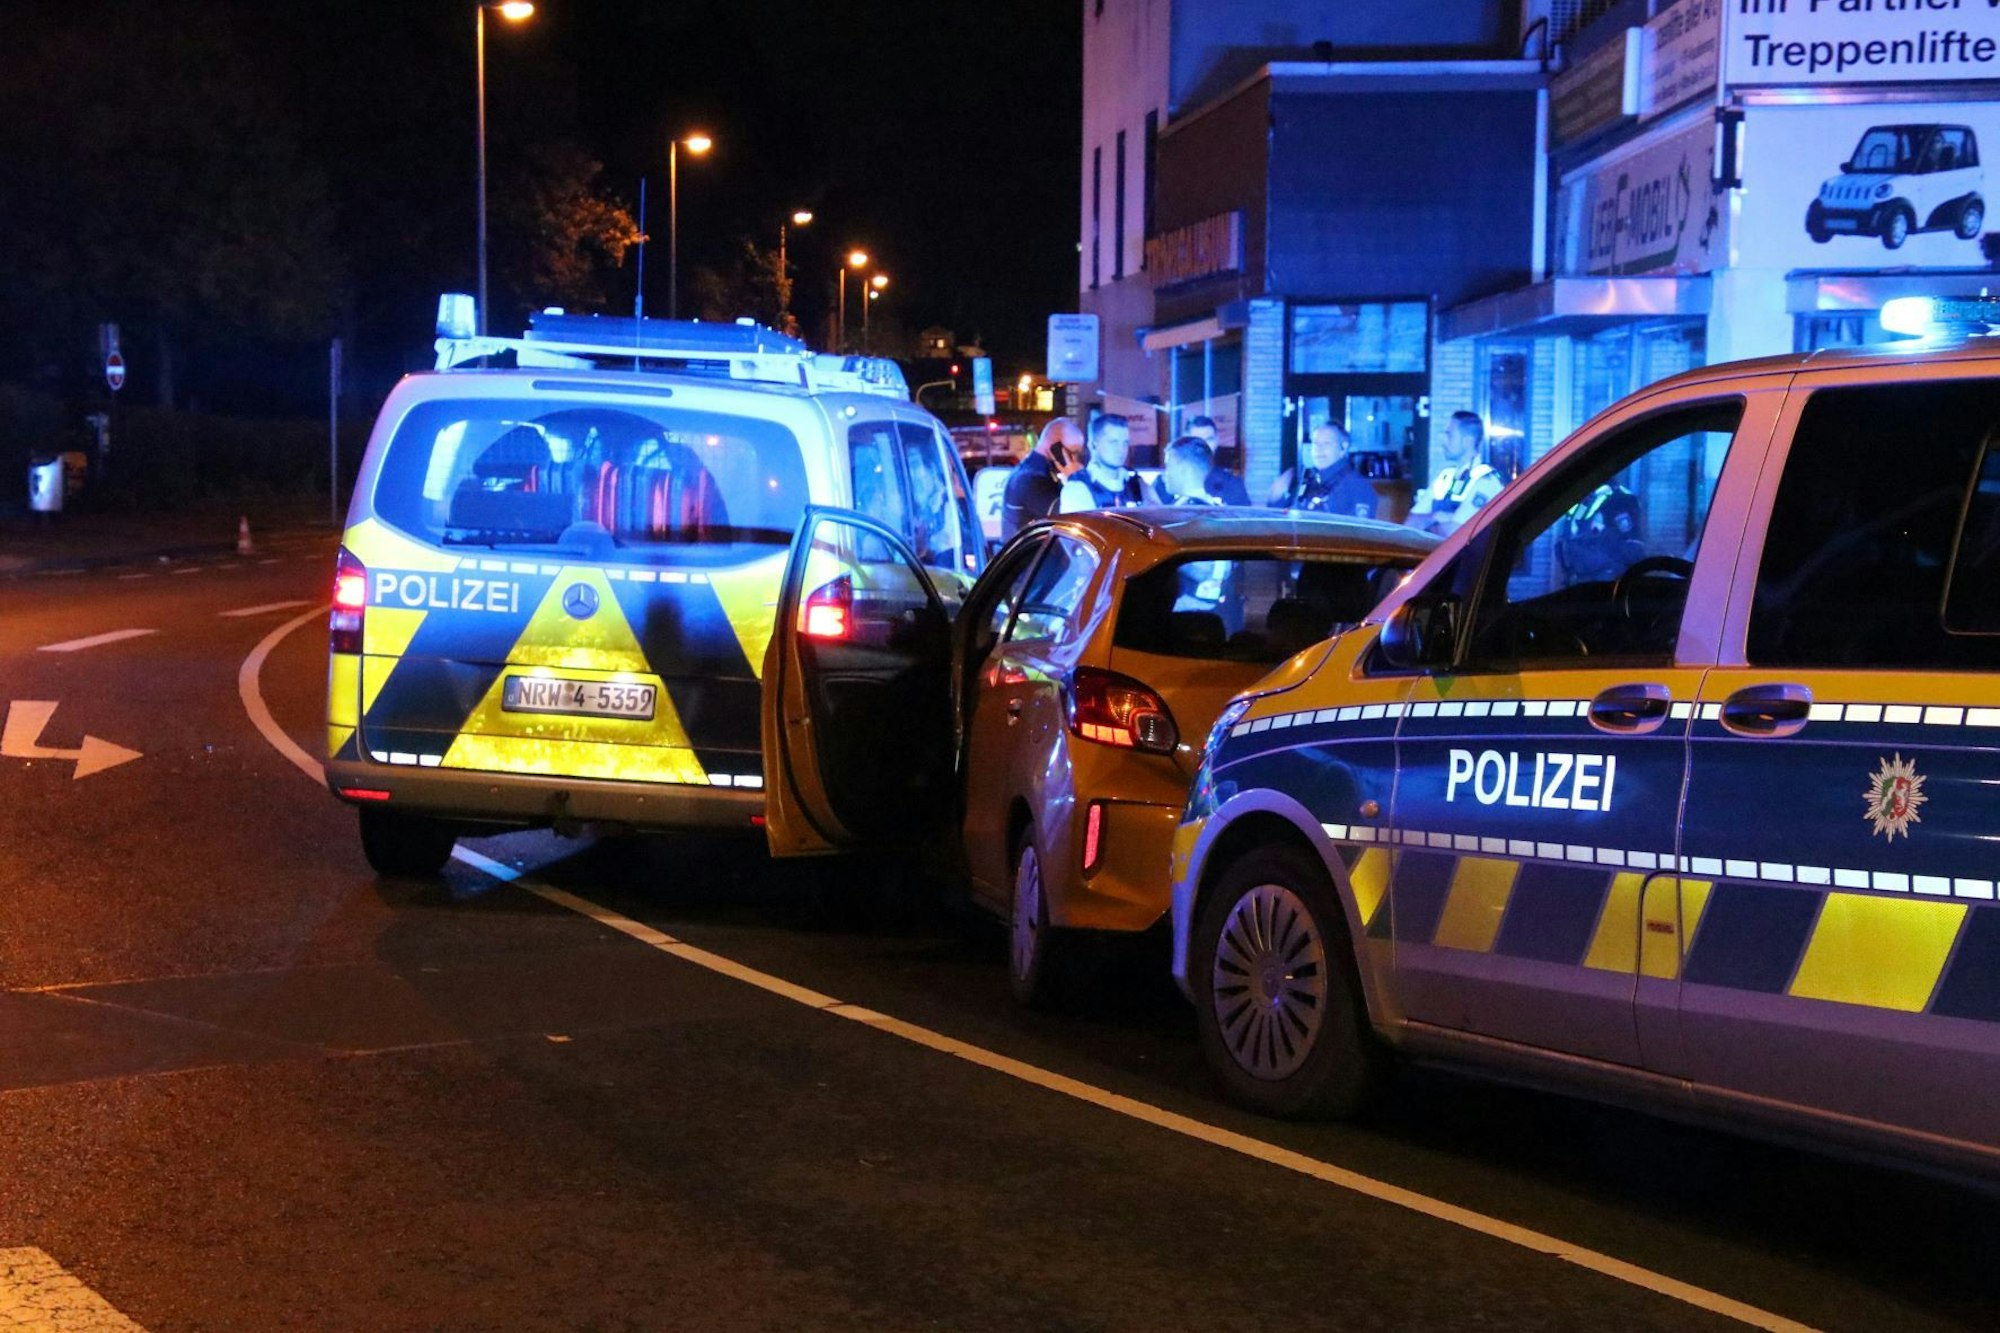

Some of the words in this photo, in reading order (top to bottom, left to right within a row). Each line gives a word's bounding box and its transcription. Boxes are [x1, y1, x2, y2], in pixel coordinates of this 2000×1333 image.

[1743, 31, 1997, 74] Treppenlifte
[374, 572, 520, 614] POLIZEI
[518, 681, 562, 706] NRW
[573, 685, 653, 712] 4-5359
[1446, 748, 1617, 812] POLIZEI
